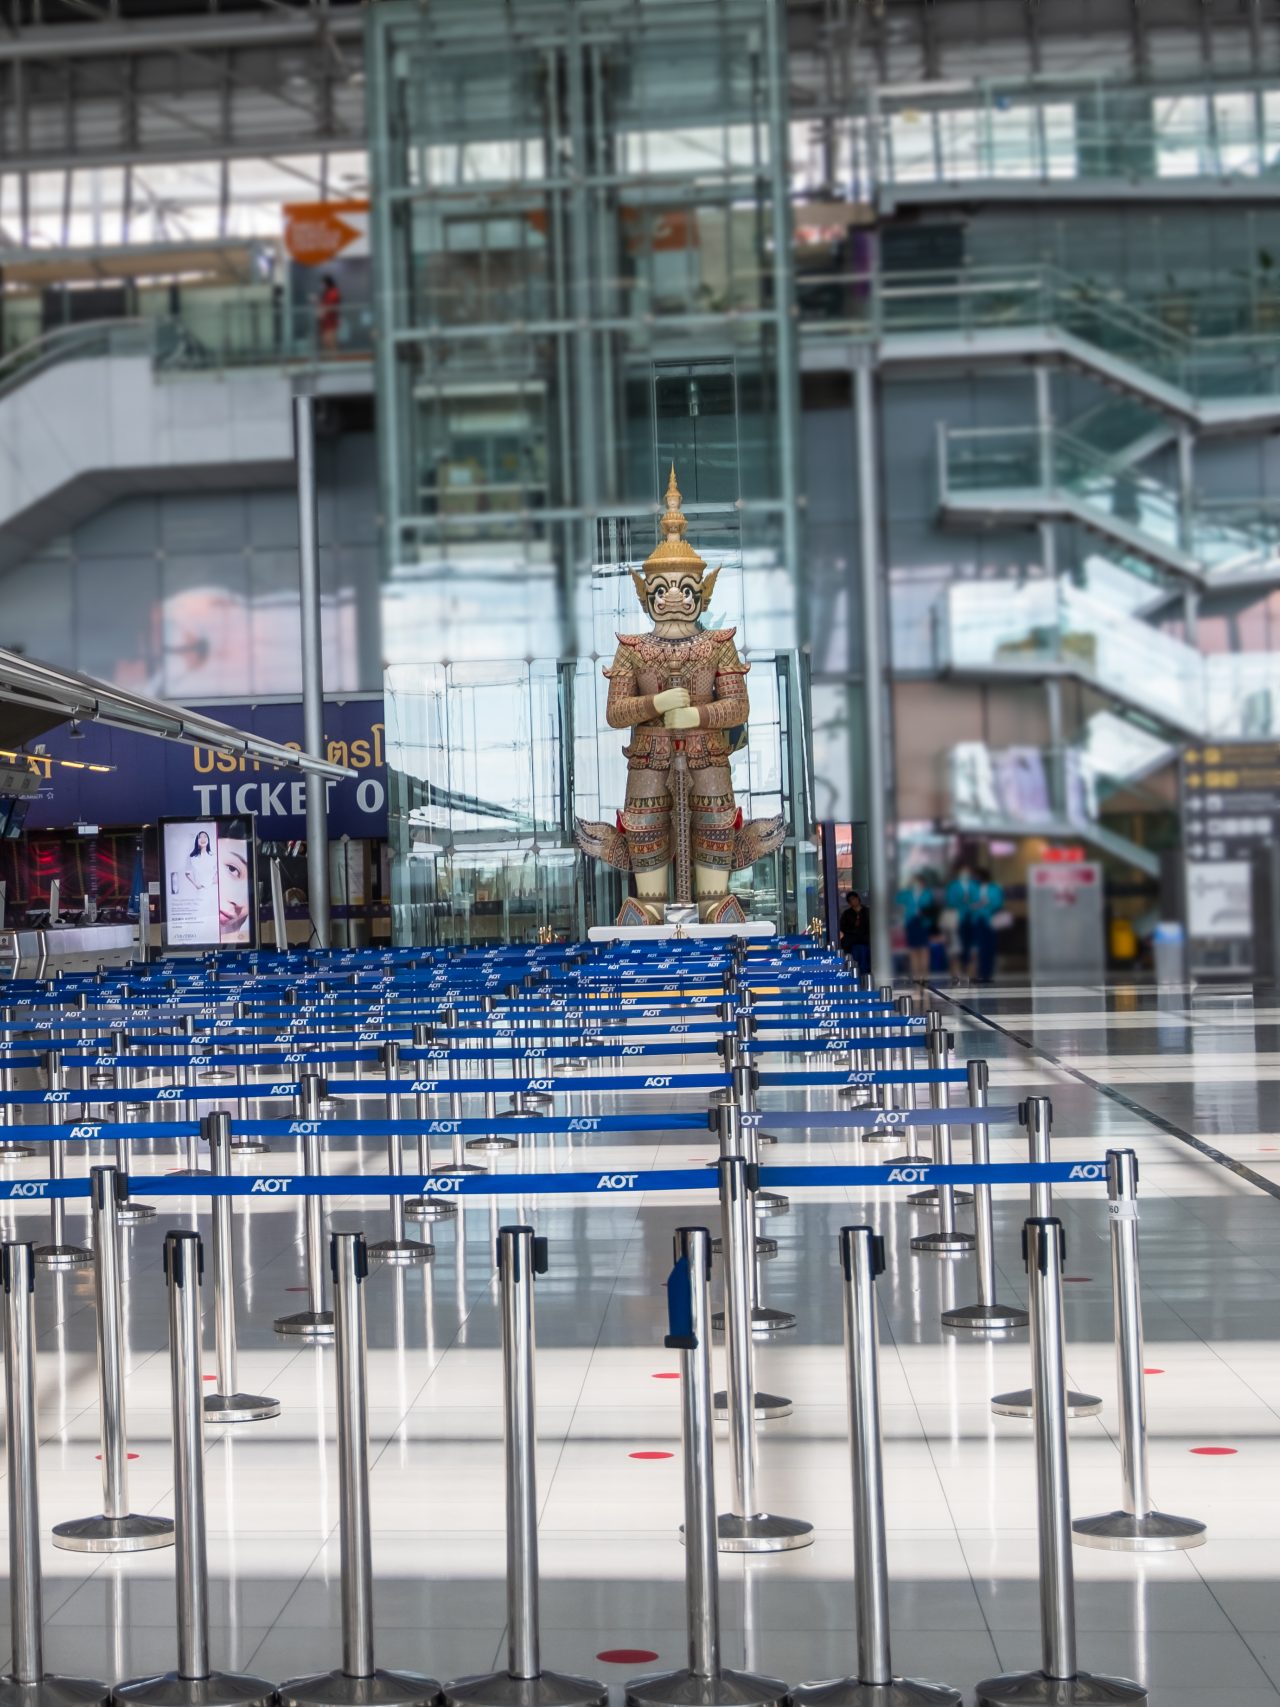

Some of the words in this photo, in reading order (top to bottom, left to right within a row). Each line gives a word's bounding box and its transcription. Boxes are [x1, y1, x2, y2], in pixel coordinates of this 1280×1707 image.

[642, 1009, 661, 1017] AOT
[215, 1019, 233, 1027] AOT
[819, 1019, 839, 1027] AOT
[581, 1027, 602, 1036] AOT
[669, 1024, 690, 1032] AOT
[359, 1032, 379, 1040] AOT
[495, 1029, 517, 1037] AOT
[77, 1039, 95, 1047] AOT
[190, 1036, 209, 1044] AOT
[275, 1035, 294, 1043] AOT
[827, 1040, 848, 1049] AOT
[428, 1050, 448, 1059] AOT
[524, 1048, 546, 1057] AOT
[622, 1046, 644, 1055] AOT
[96, 1057, 117, 1066] AOT
[188, 1056, 211, 1065] AOT
[285, 1053, 306, 1062] AOT
[644, 1076, 672, 1087] AOT
[846, 1072, 875, 1083] AOT
[411, 1081, 438, 1090] AOT
[527, 1079, 554, 1090] AOT
[156, 1088, 183, 1099] AOT
[270, 1084, 299, 1095] AOT
[44, 1091, 70, 1102] AOT
[741, 1116, 762, 1125] OT
[874, 1112, 909, 1124] AOT
[289, 1122, 322, 1134] AOT
[429, 1121, 462, 1133] AOT
[568, 1118, 604, 1129] AOT
[70, 1127, 104, 1138] AOT
[888, 1168, 929, 1183] AOT
[252, 1178, 291, 1192] AOT
[423, 1177, 464, 1191] AOT
[597, 1174, 638, 1189] AOT
[9, 1182, 48, 1196] AOT
